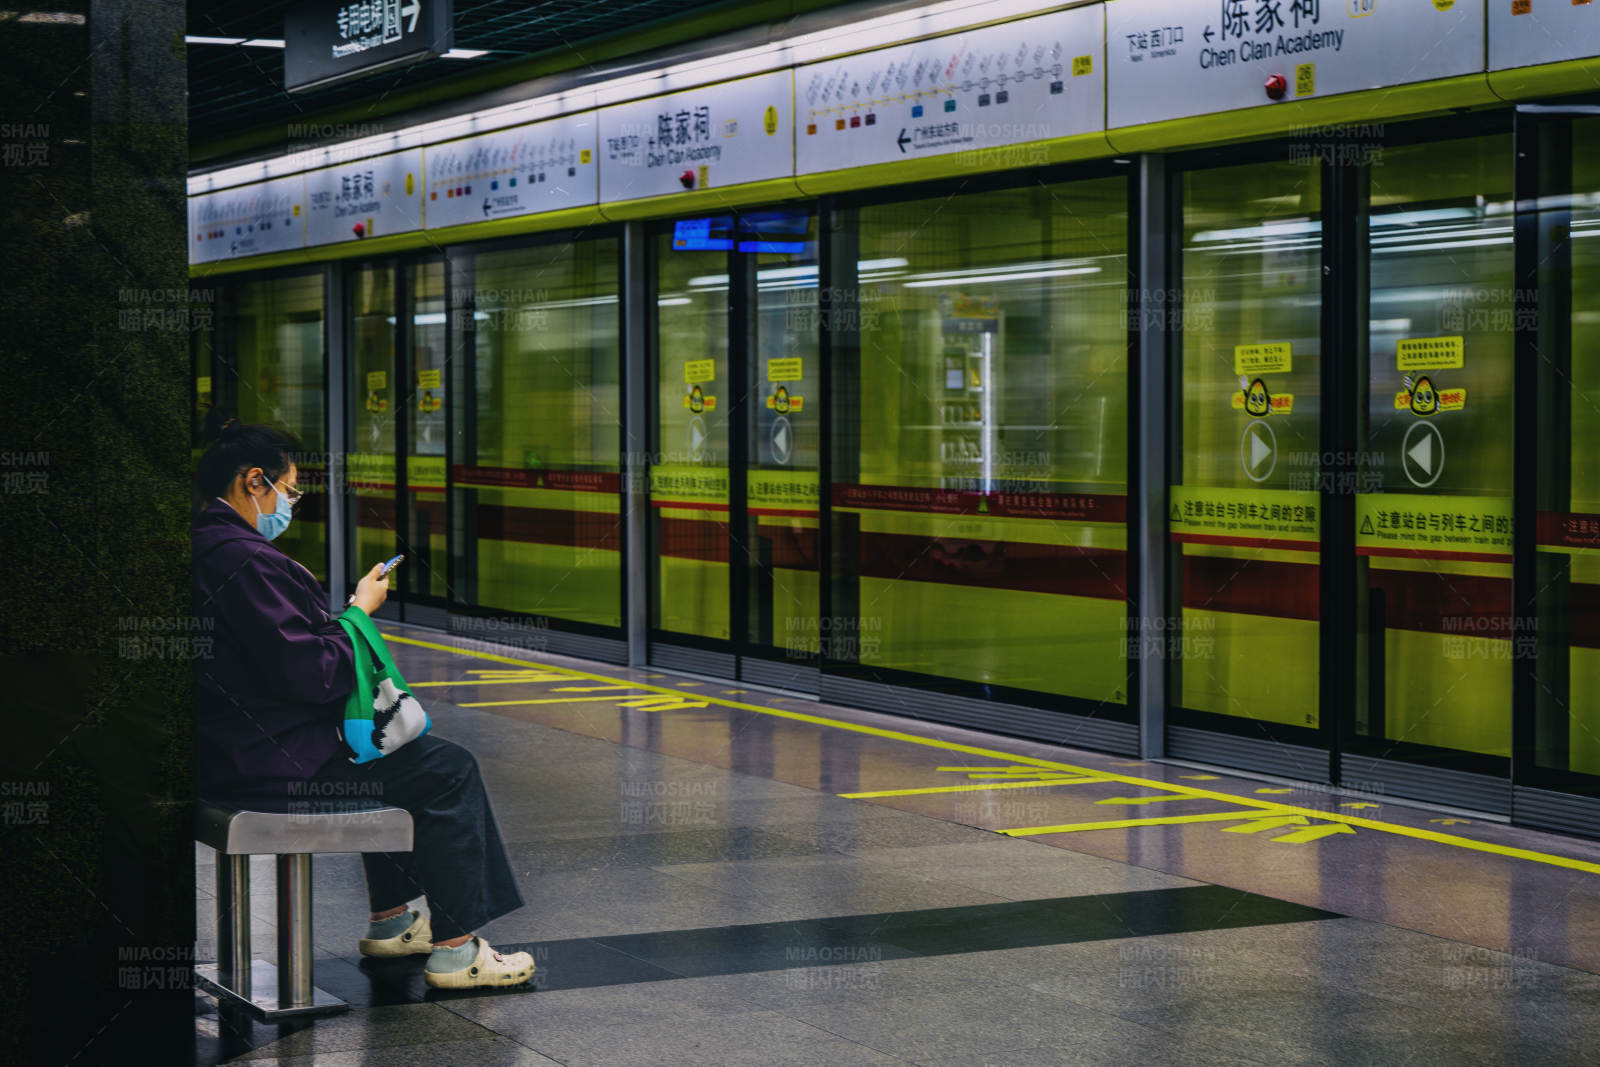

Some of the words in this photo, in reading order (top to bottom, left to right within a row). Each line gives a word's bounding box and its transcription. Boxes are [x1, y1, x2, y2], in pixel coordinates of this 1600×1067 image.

[1221, 0, 1320, 41] 陈家祠
[1200, 48, 1236, 69] Chen
[1240, 40, 1271, 62] Clan
[1275, 29, 1344, 56] Academy
[657, 106, 710, 149] 陈家祠
[1184, 500, 1316, 522] 注意站台与列车之间的空隙
